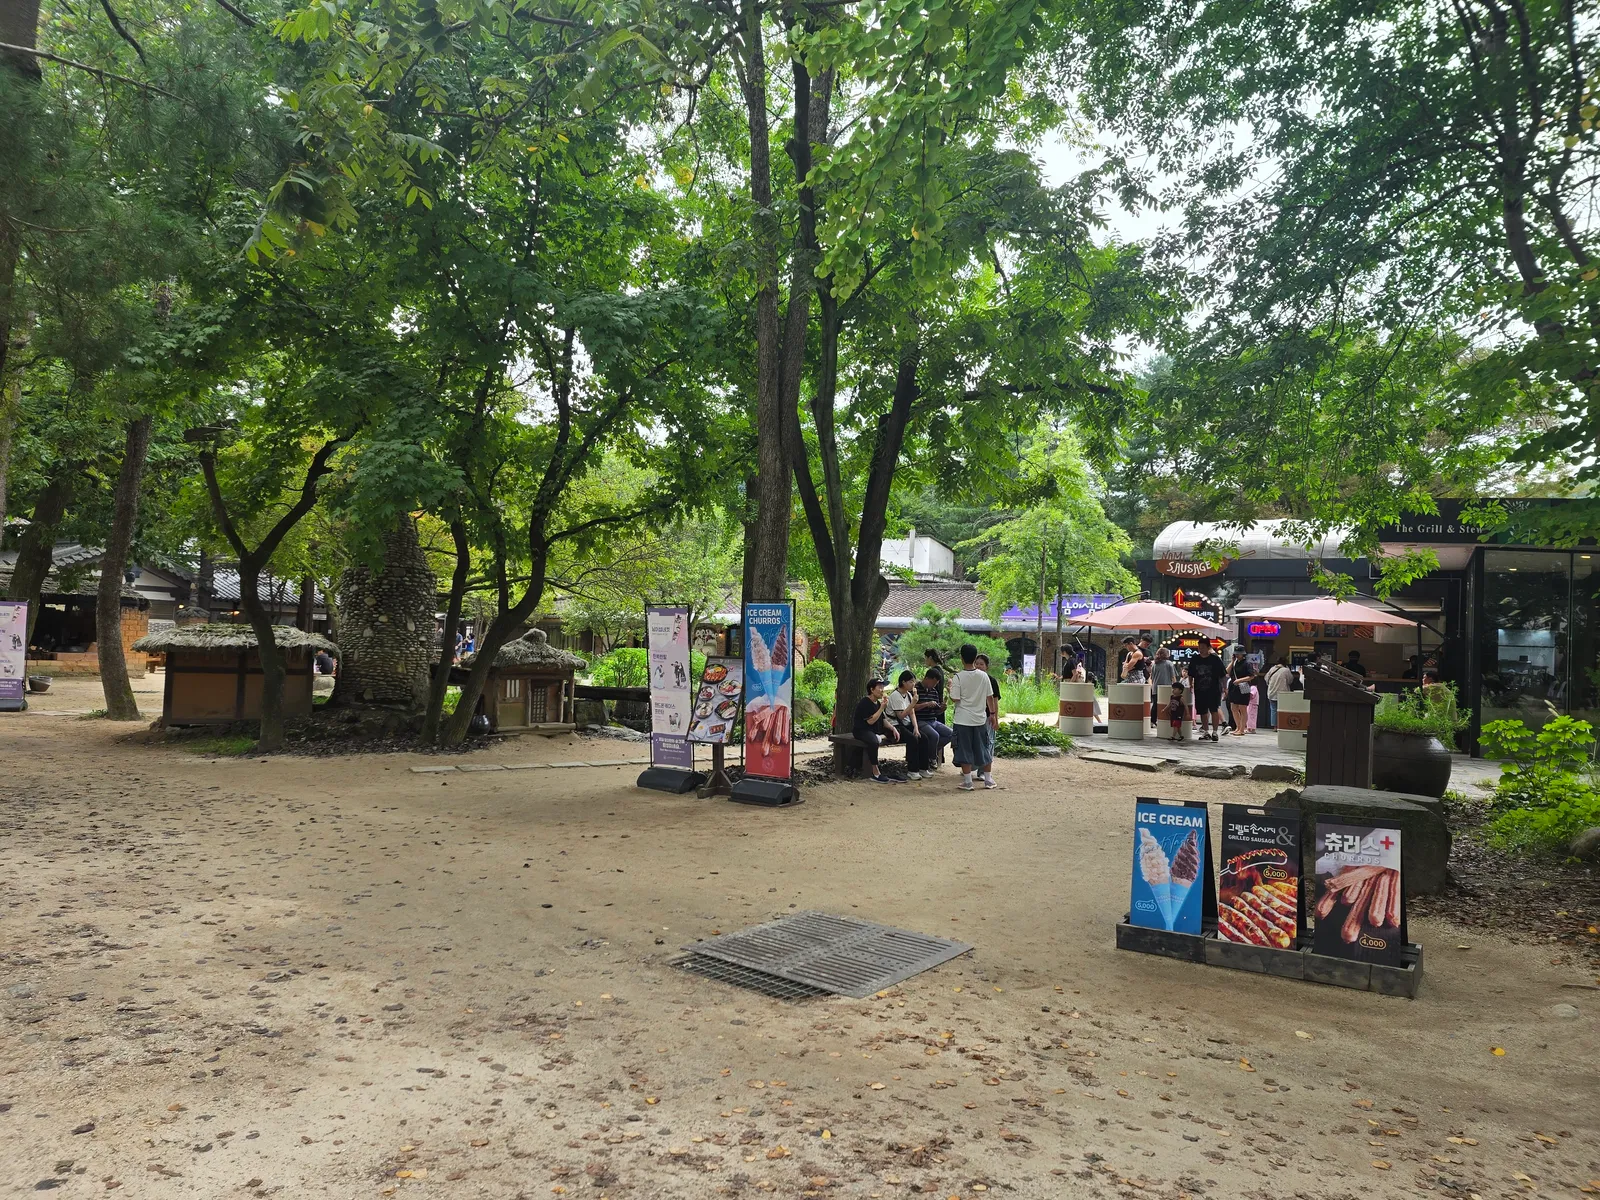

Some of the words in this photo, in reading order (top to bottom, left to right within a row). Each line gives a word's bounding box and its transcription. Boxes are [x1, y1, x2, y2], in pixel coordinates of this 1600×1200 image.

[1395, 524, 1414, 533] The
[1417, 524, 1443, 534] Grill
[1446, 524, 1455, 534] &
[1166, 560, 1212, 576] SAUSAGE
[747, 609, 758, 617] ICE
[758, 608, 782, 617] CREAM
[748, 617, 781, 625] CHURROS
[1250, 624, 1278, 634] OPEN
[1137, 812, 1157, 823] ICE
[1159, 814, 1203, 828] CREAM
[1227, 834, 1250, 842] GRILLED
[1250, 837, 1276, 845] SAUSAGE
[1276, 826, 1296, 847] &
[1324, 832, 1381, 856] 츄러스
